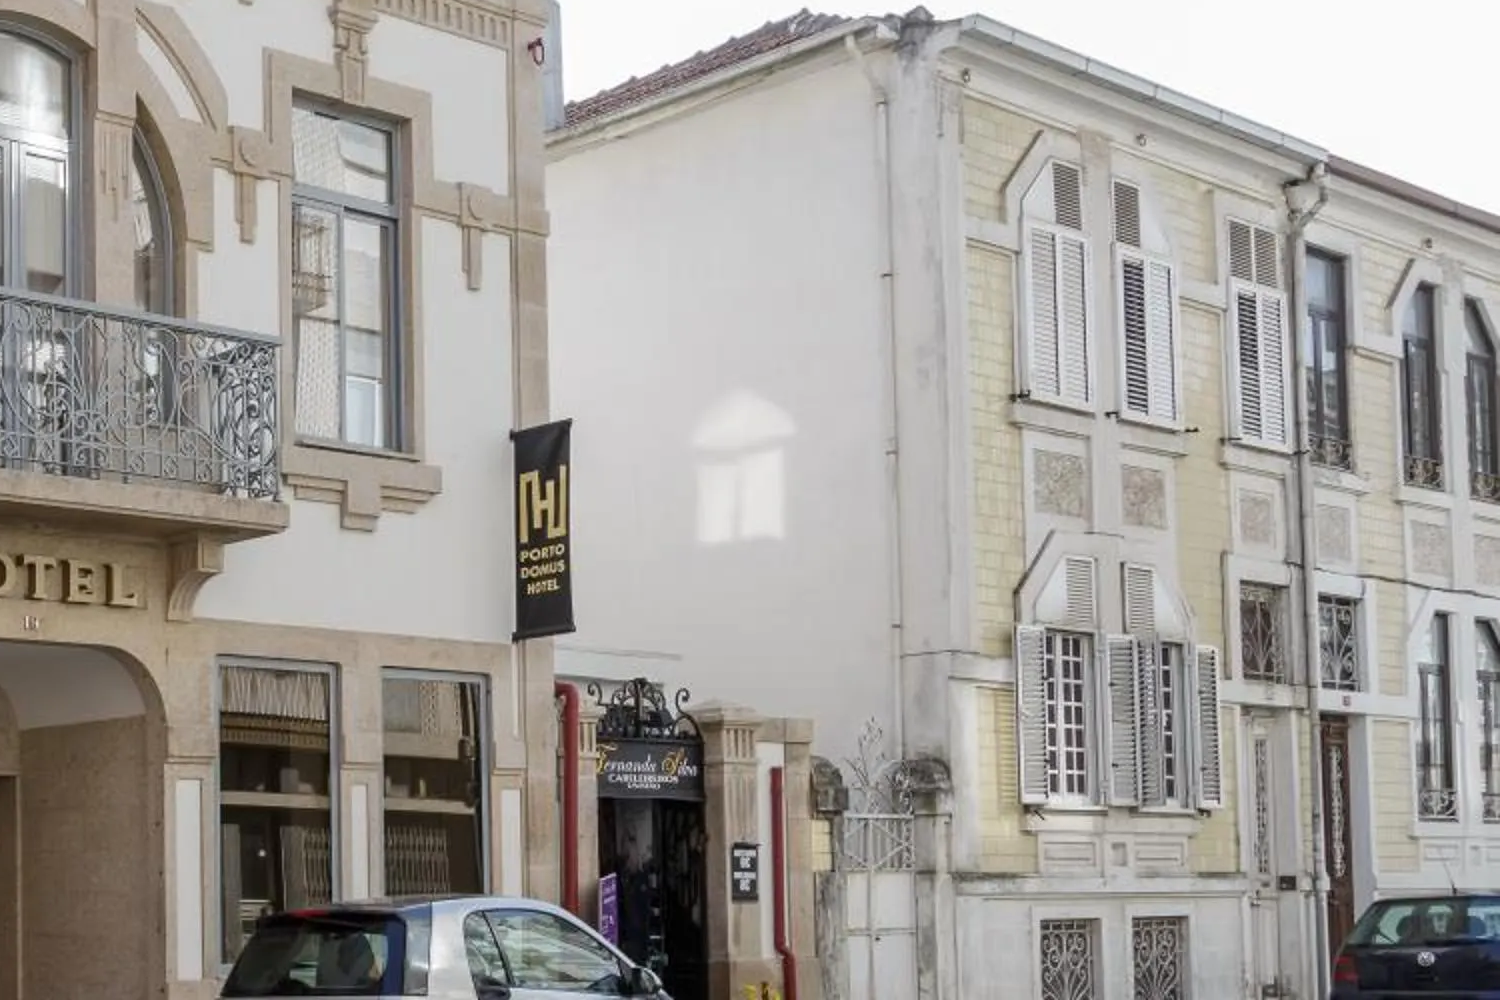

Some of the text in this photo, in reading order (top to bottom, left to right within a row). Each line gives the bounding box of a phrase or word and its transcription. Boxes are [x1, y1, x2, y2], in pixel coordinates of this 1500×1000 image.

[520, 543, 565, 562] PORTO
[520, 559, 565, 579] DOMUS
[527, 577, 560, 595] HOTEL
